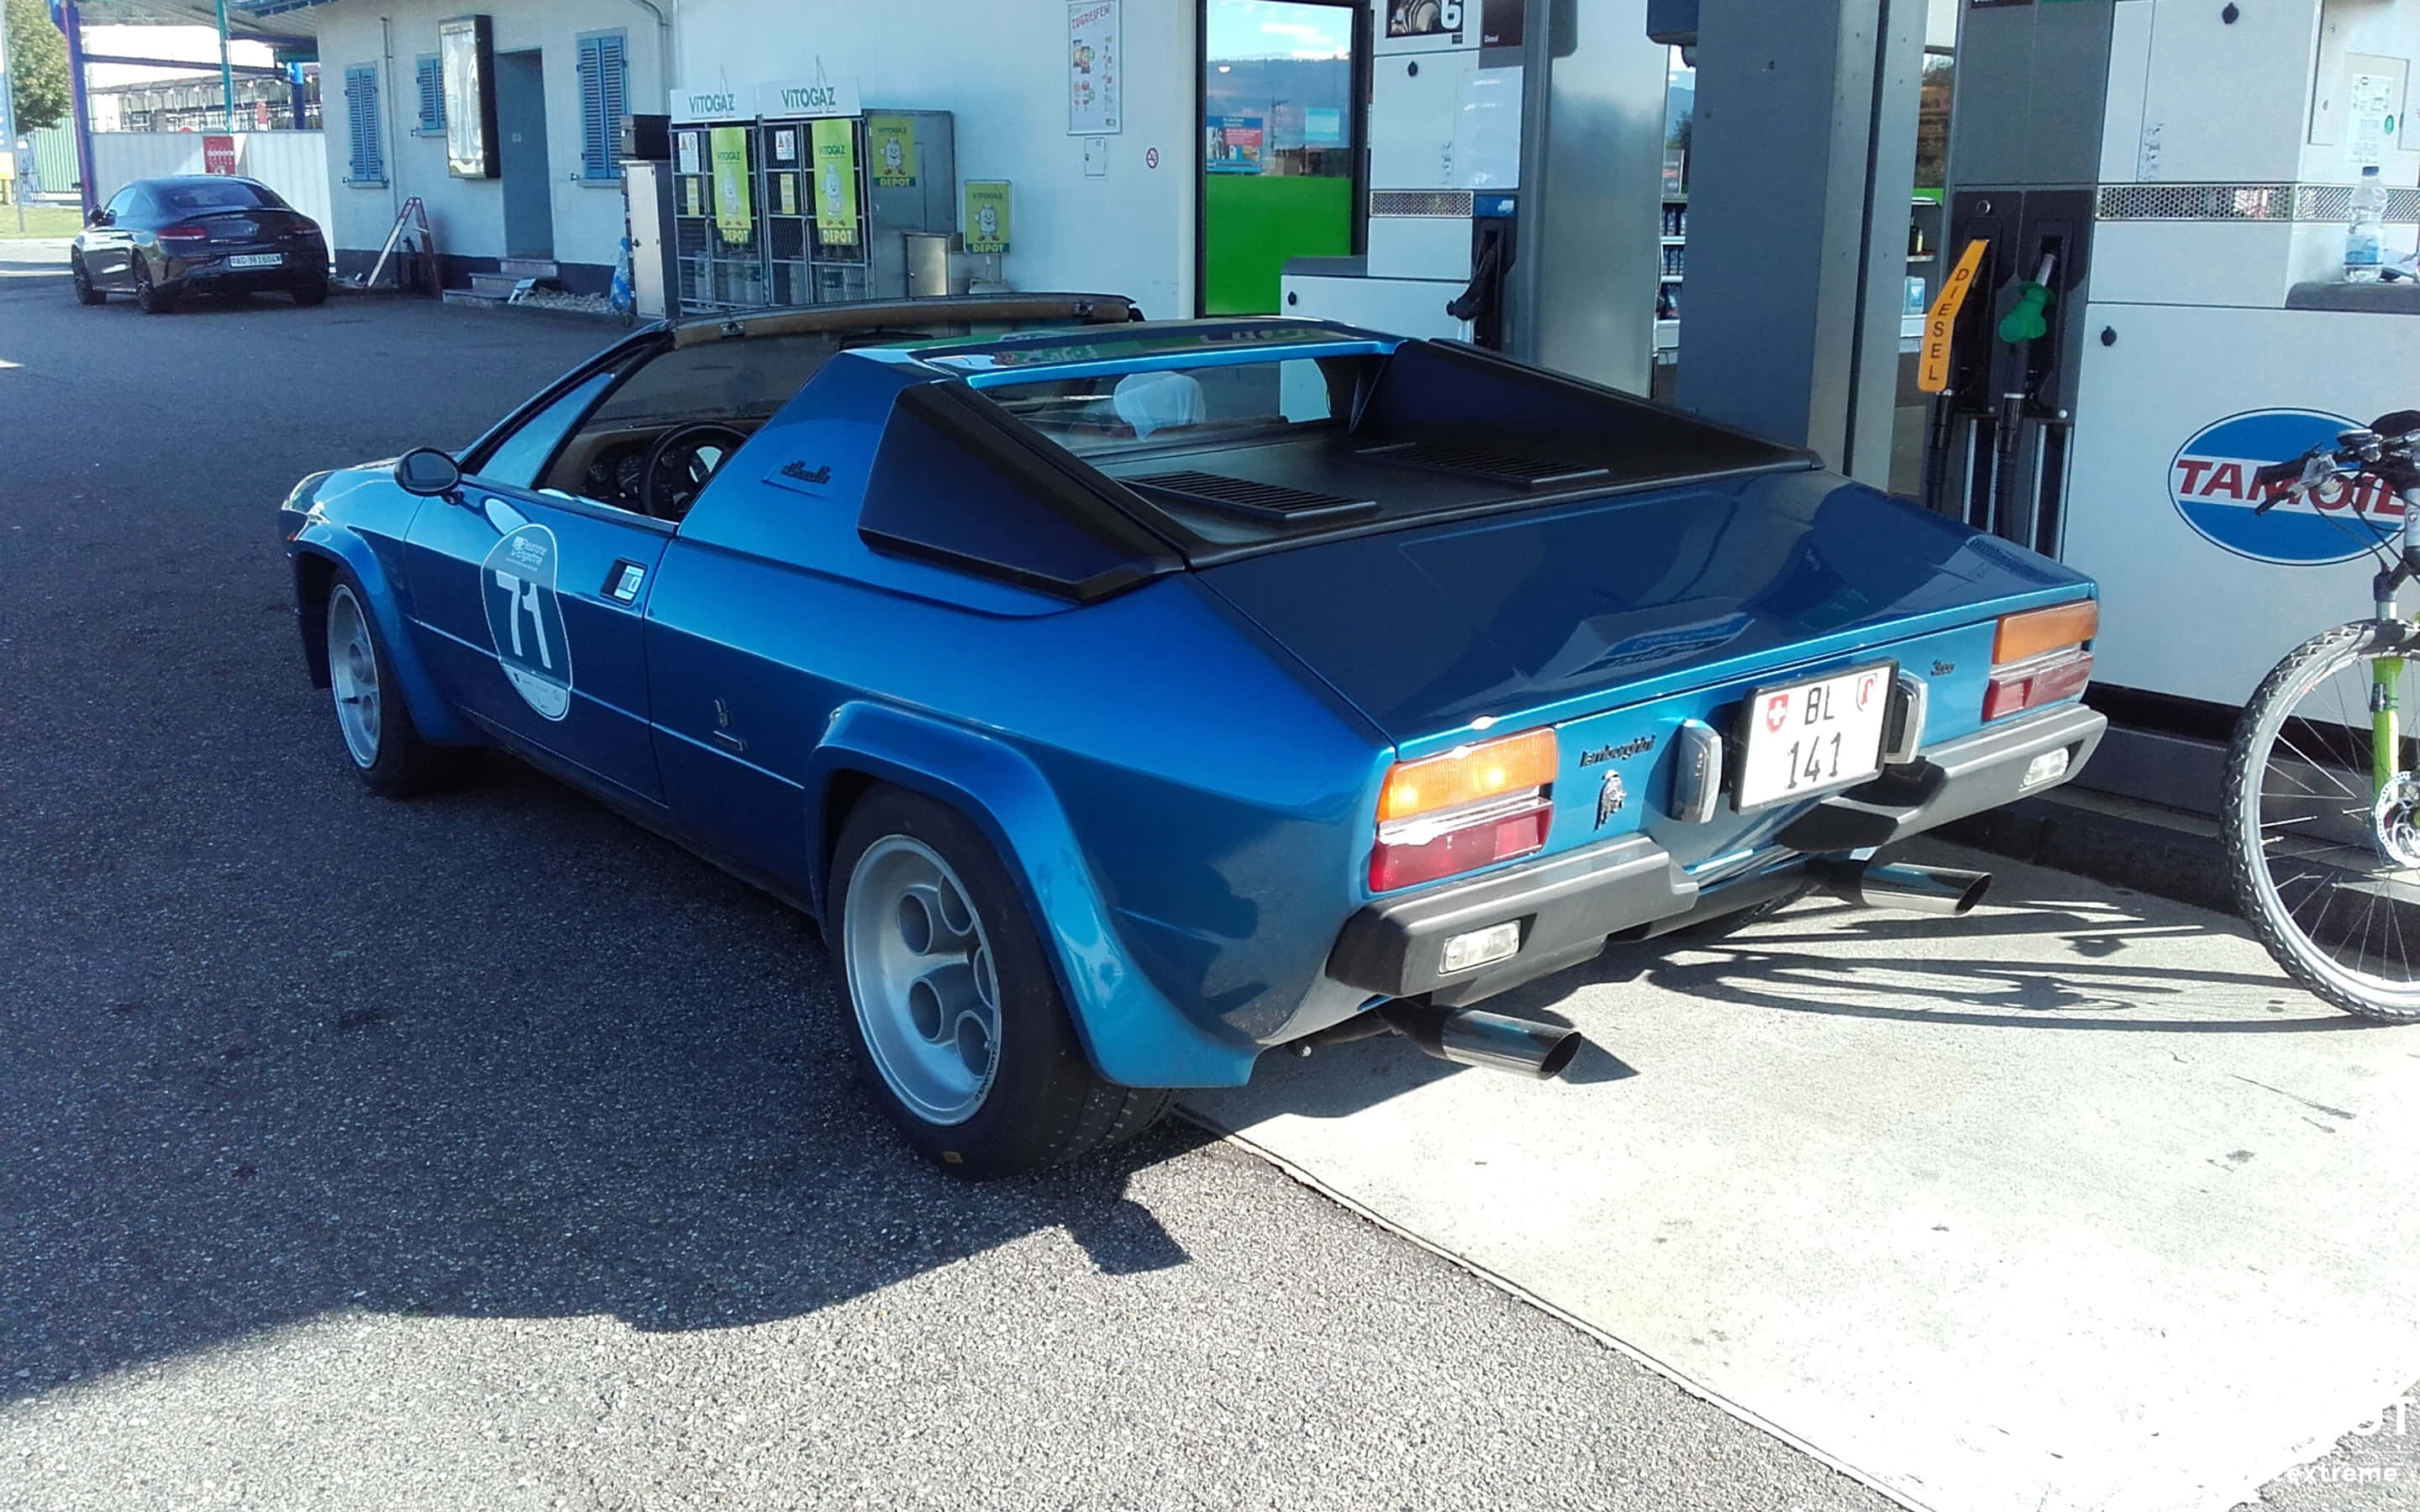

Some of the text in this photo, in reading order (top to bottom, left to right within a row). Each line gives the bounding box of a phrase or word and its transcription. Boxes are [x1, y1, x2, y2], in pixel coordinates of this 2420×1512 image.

[1928, 268, 1970, 381] DIESEL
[495, 569, 552, 669] 71
[1804, 685, 1834, 726] BL
[1786, 731, 1843, 791] 141
